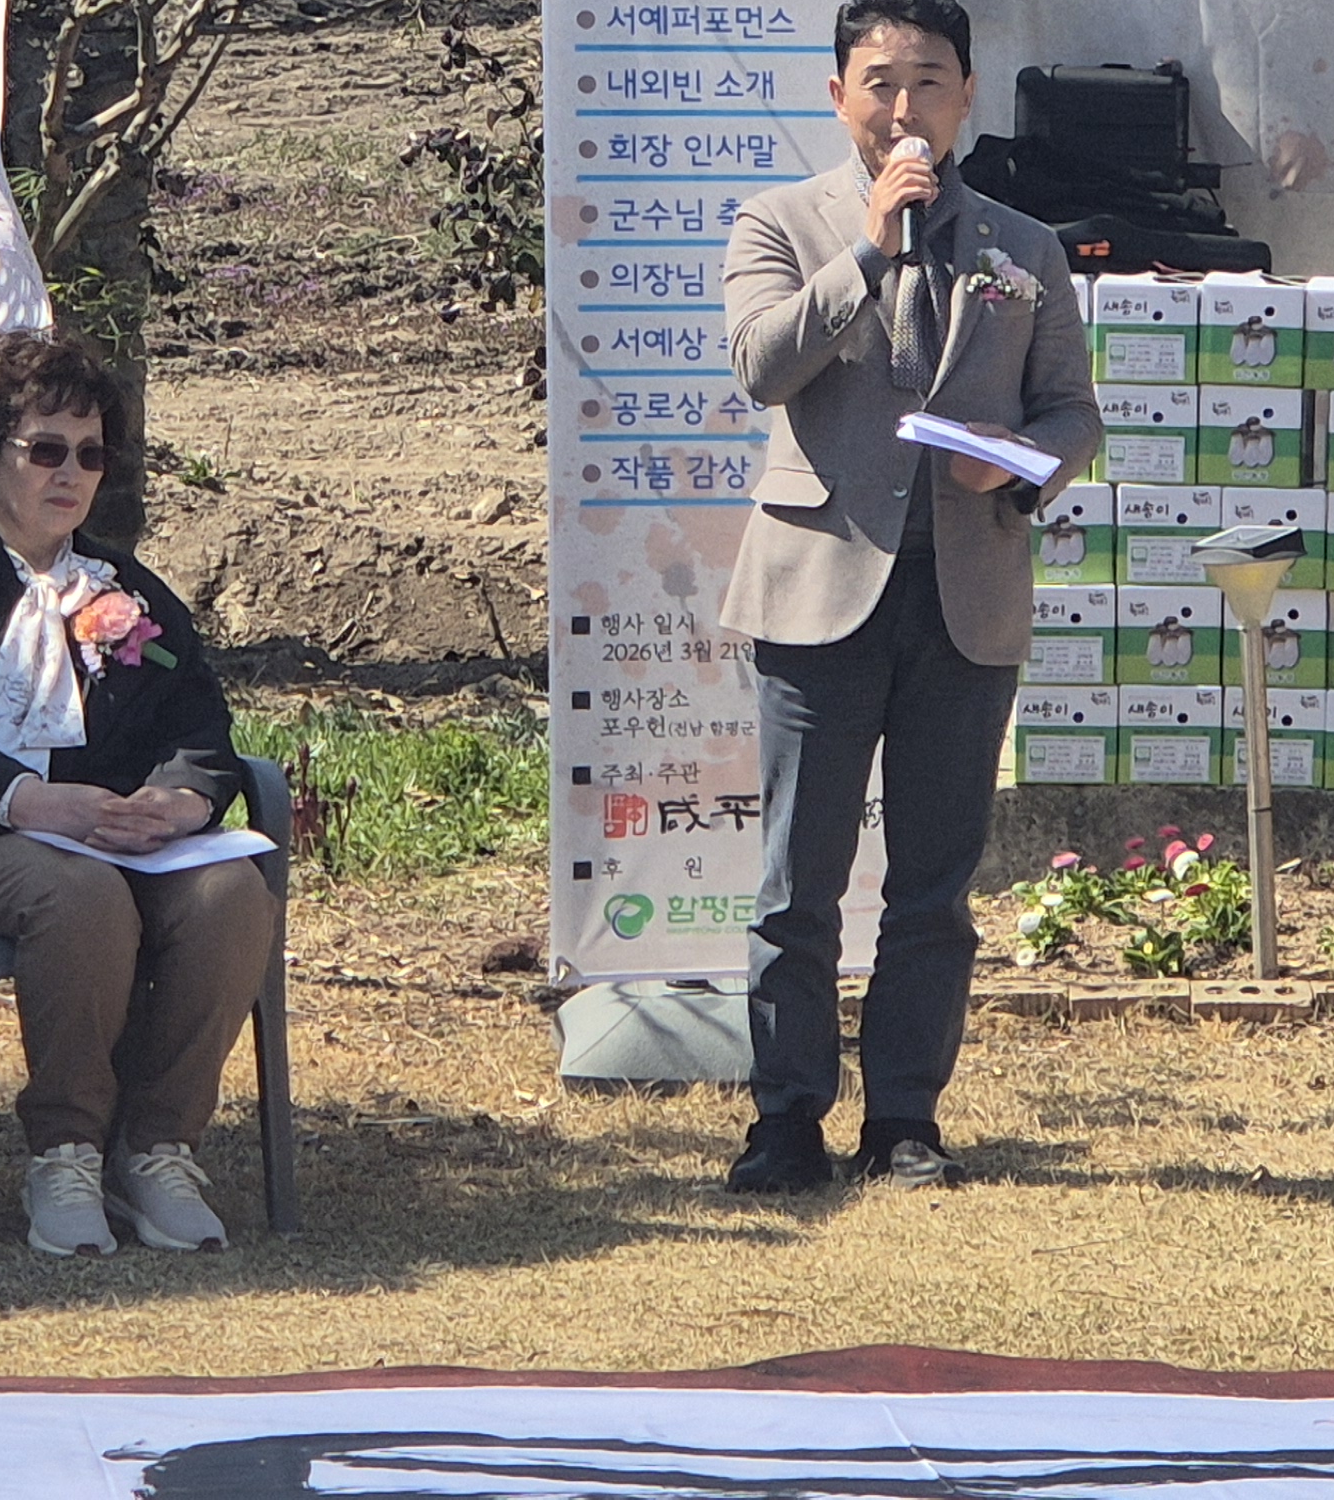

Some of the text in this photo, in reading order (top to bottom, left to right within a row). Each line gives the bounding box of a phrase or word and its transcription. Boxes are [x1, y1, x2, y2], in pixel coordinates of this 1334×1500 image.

[607, 5, 796, 40] 서예퍼포먼스
[607, 69, 776, 103] 내외빈 소개
[608, 134, 778, 169] 회장 인사말
[609, 198, 704, 233] 군수님
[610, 263, 705, 298] 의장님
[611, 327, 707, 362] 서예상
[611, 391, 707, 426] 공로상
[611, 455, 751, 491] 작품 감상
[600, 612, 696, 636] 행사 일시
[1033, 601, 1066, 619] 송이
[602, 640, 673, 663] 2026년
[680, 639, 712, 662] 3월
